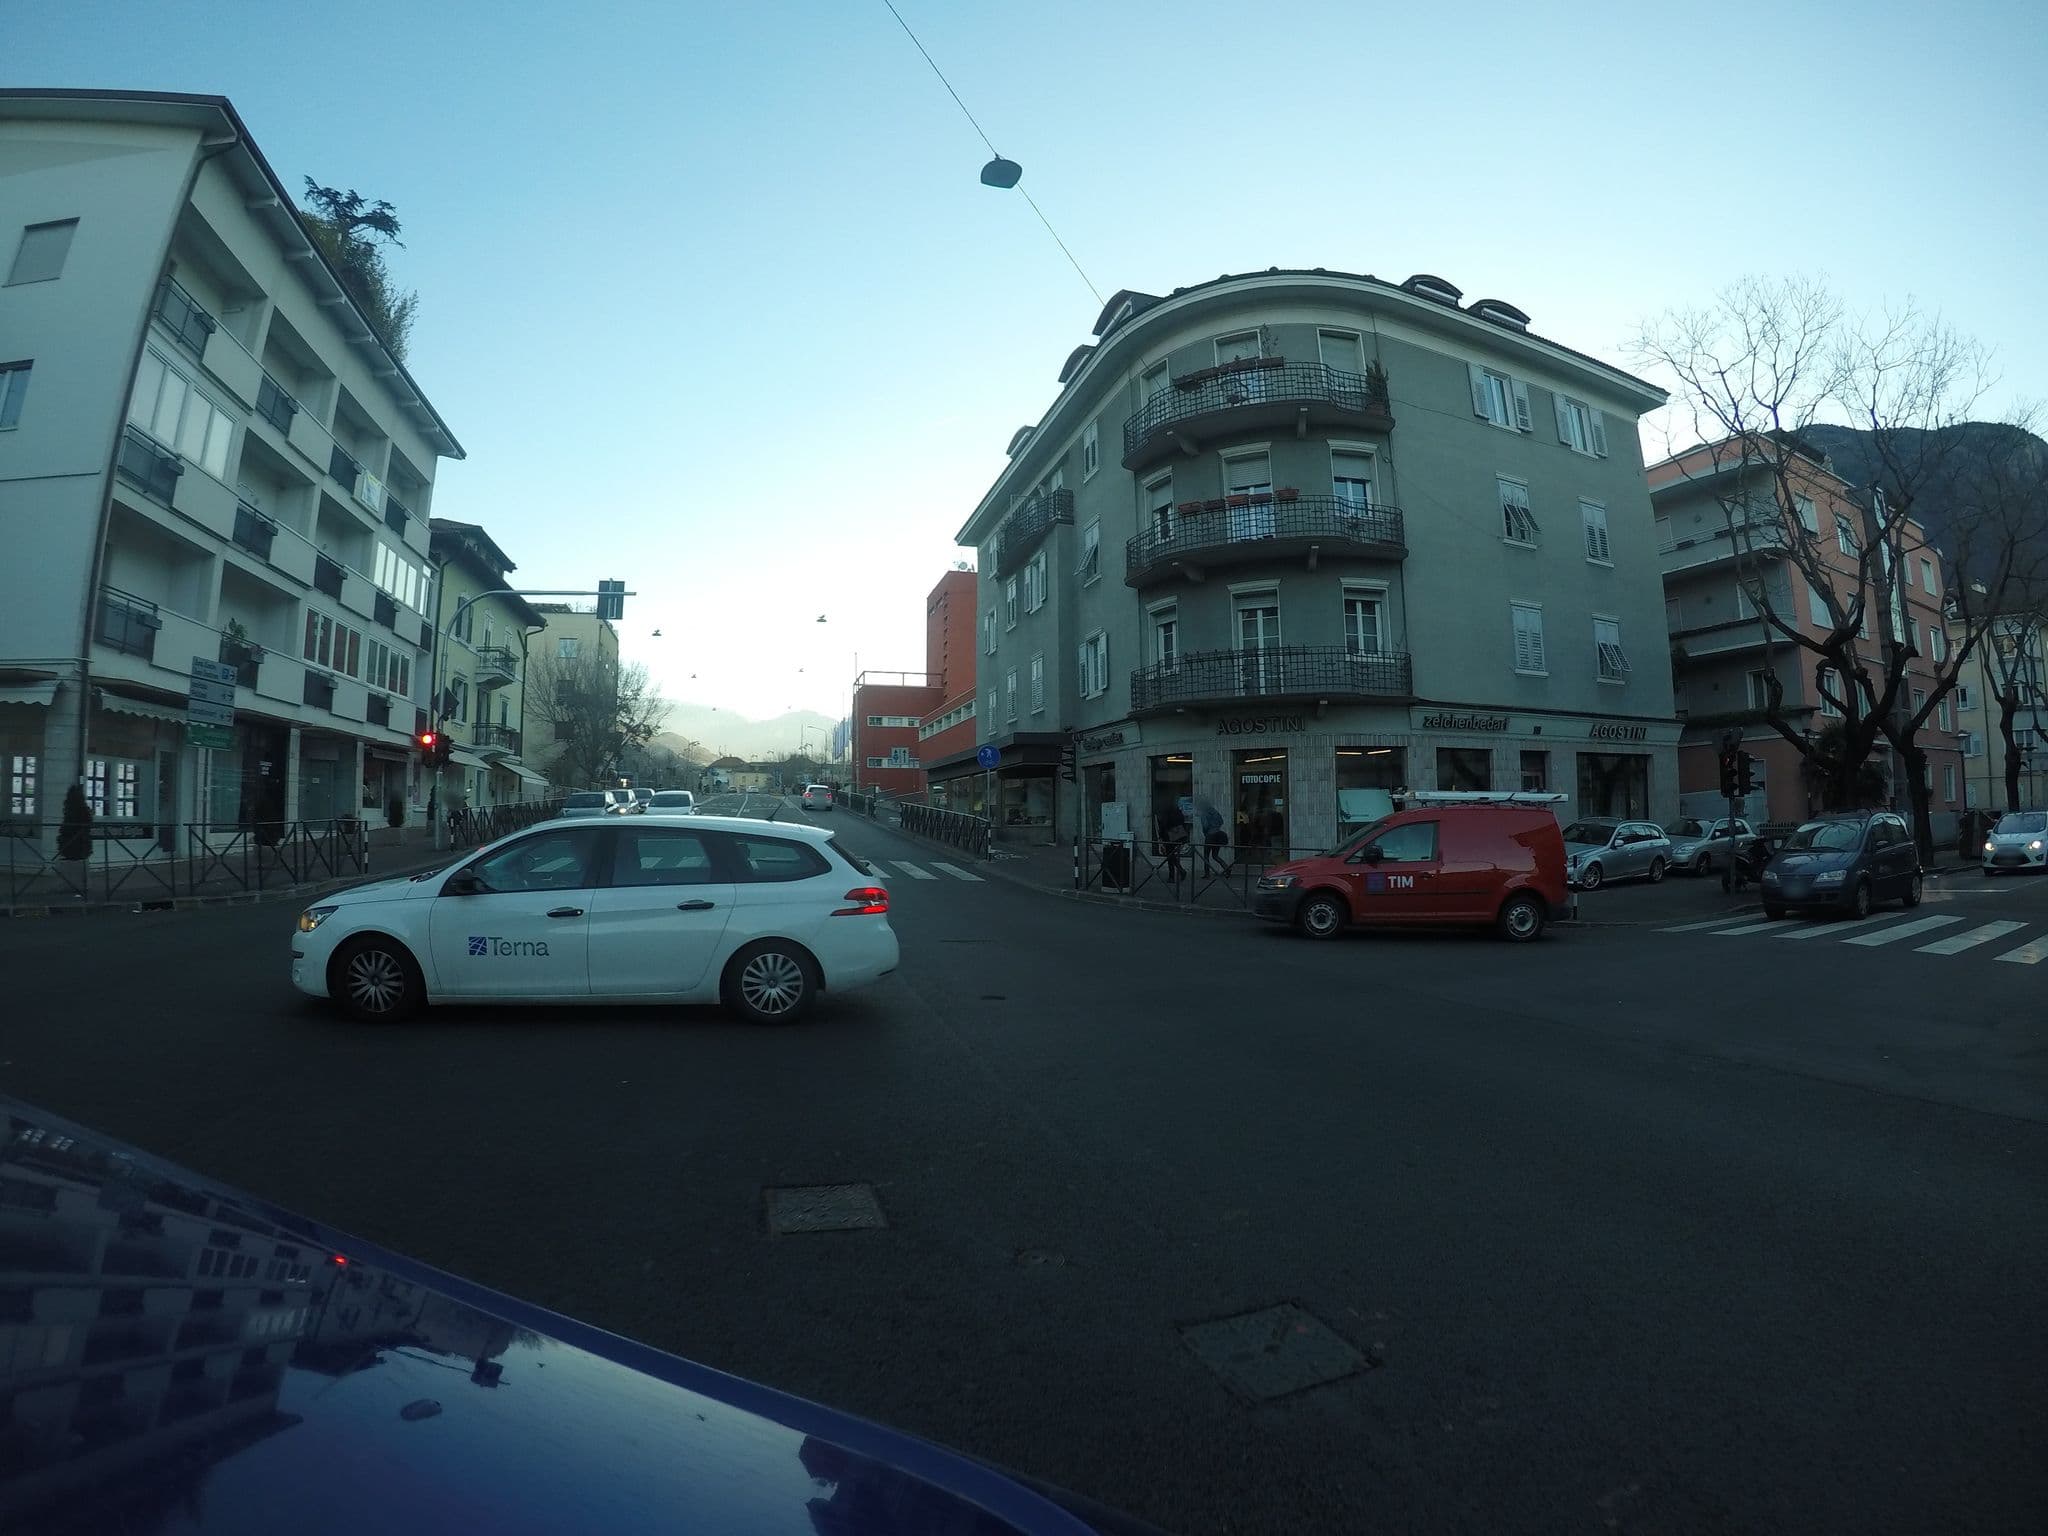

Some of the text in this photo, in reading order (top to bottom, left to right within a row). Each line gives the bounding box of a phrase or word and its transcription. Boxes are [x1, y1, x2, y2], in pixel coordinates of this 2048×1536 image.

[1216, 715, 1306, 736] AGOSTINI
[1589, 723, 1648, 741] AGOSTINI
[1241, 774, 1281, 785] FOTOCOPIE
[1387, 874, 1414, 889] TIM
[487, 936, 550, 957] Terna
